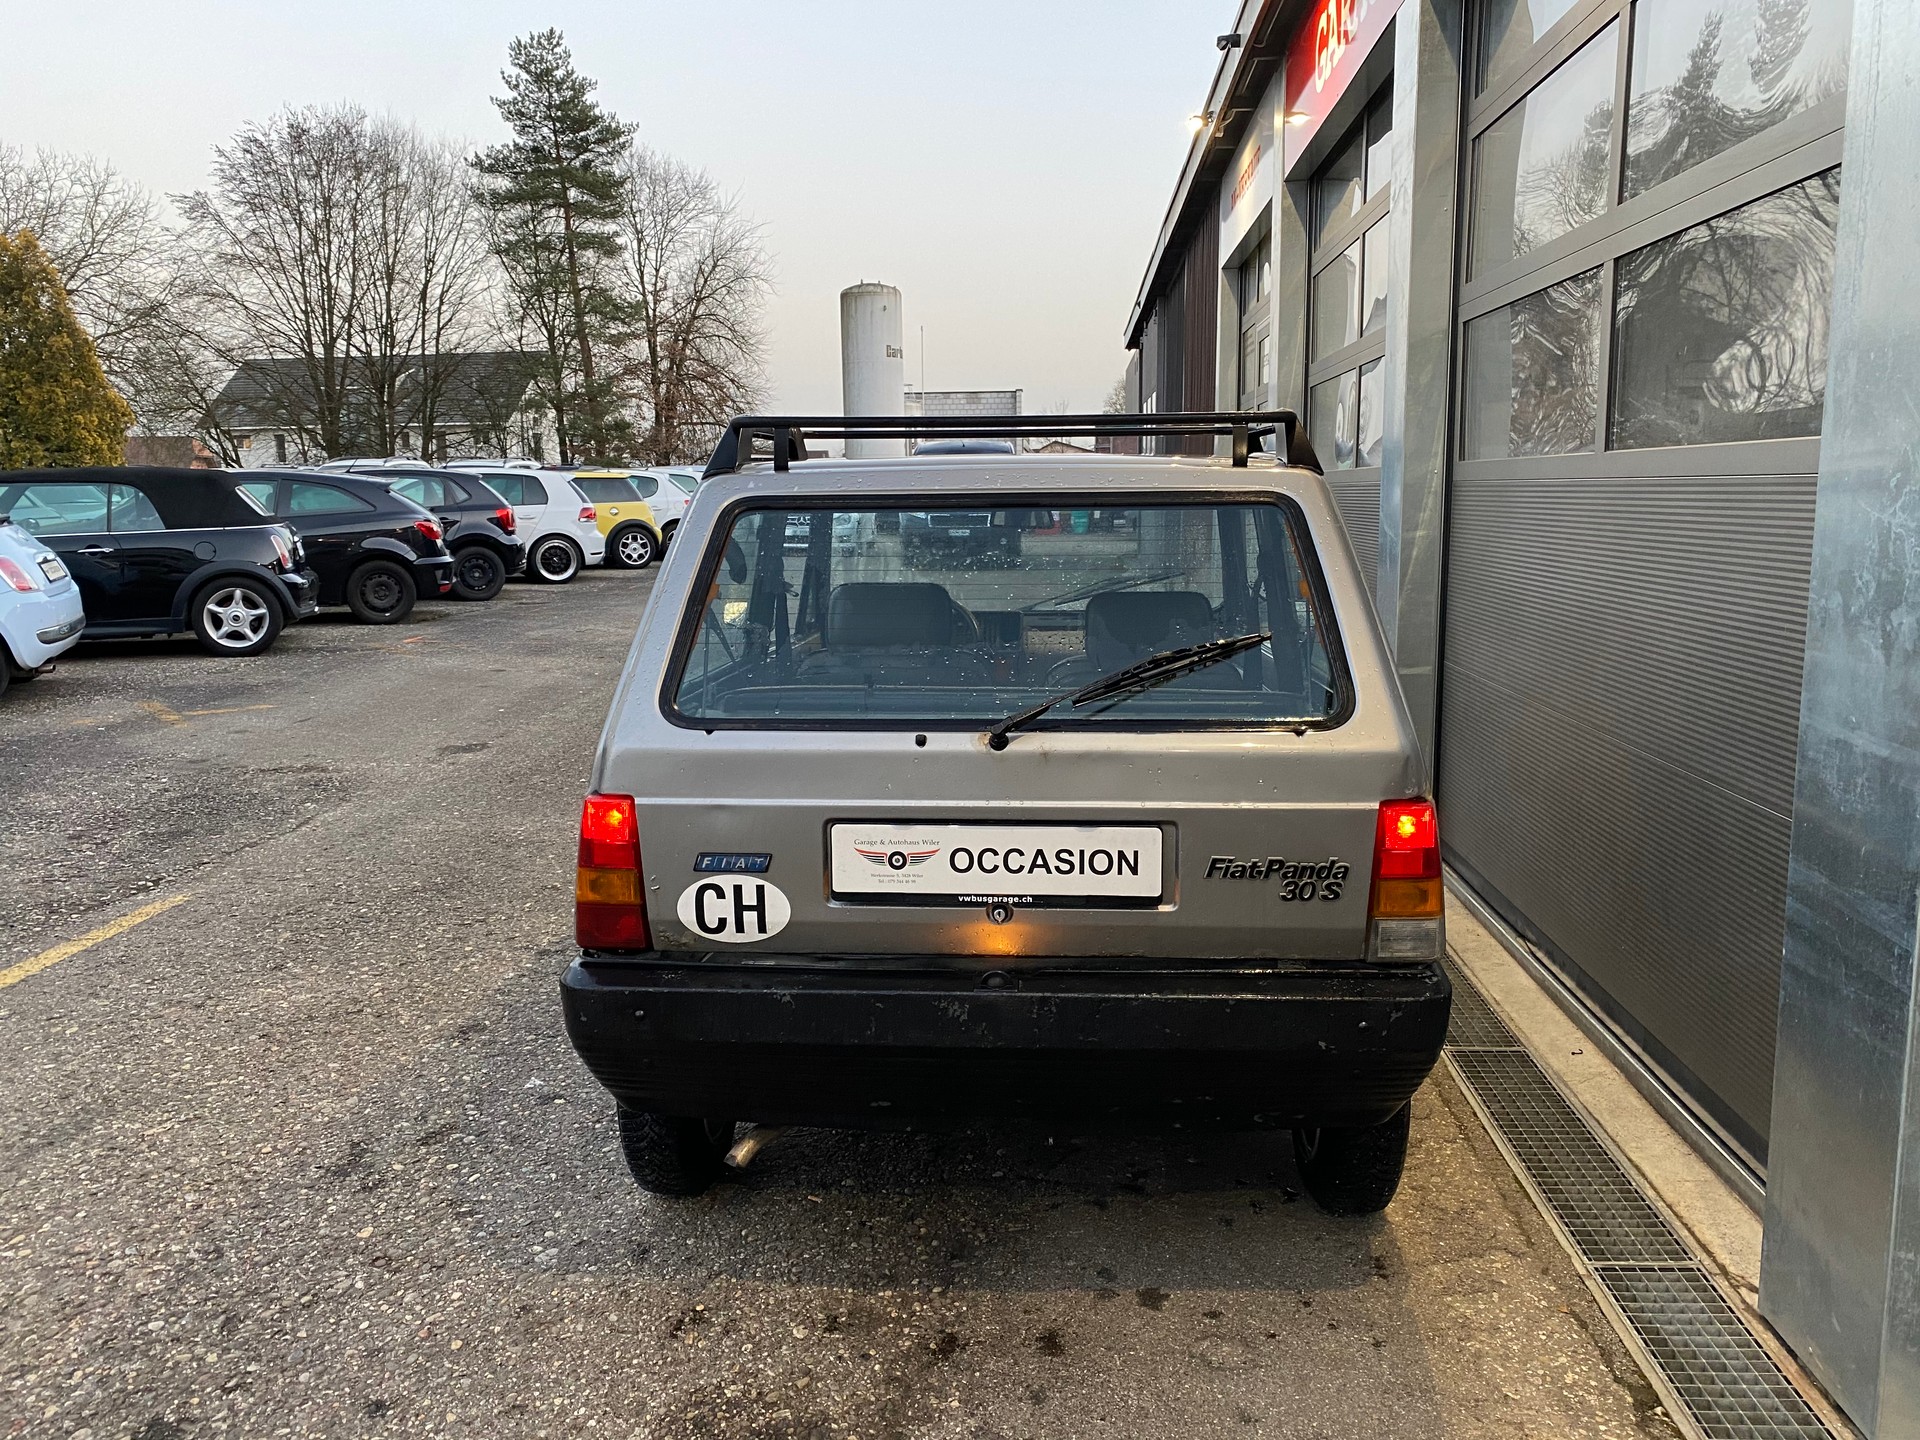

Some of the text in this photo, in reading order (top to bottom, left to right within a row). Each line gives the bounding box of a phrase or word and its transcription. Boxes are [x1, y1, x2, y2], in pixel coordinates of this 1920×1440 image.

[702, 856, 764, 868] FIAT
[949, 847, 1139, 876] OCCASION
[958, 894, 1033, 904] vwbusgarage.ch
[1279, 879, 1344, 901] 30 S
[694, 882, 767, 935] CH
